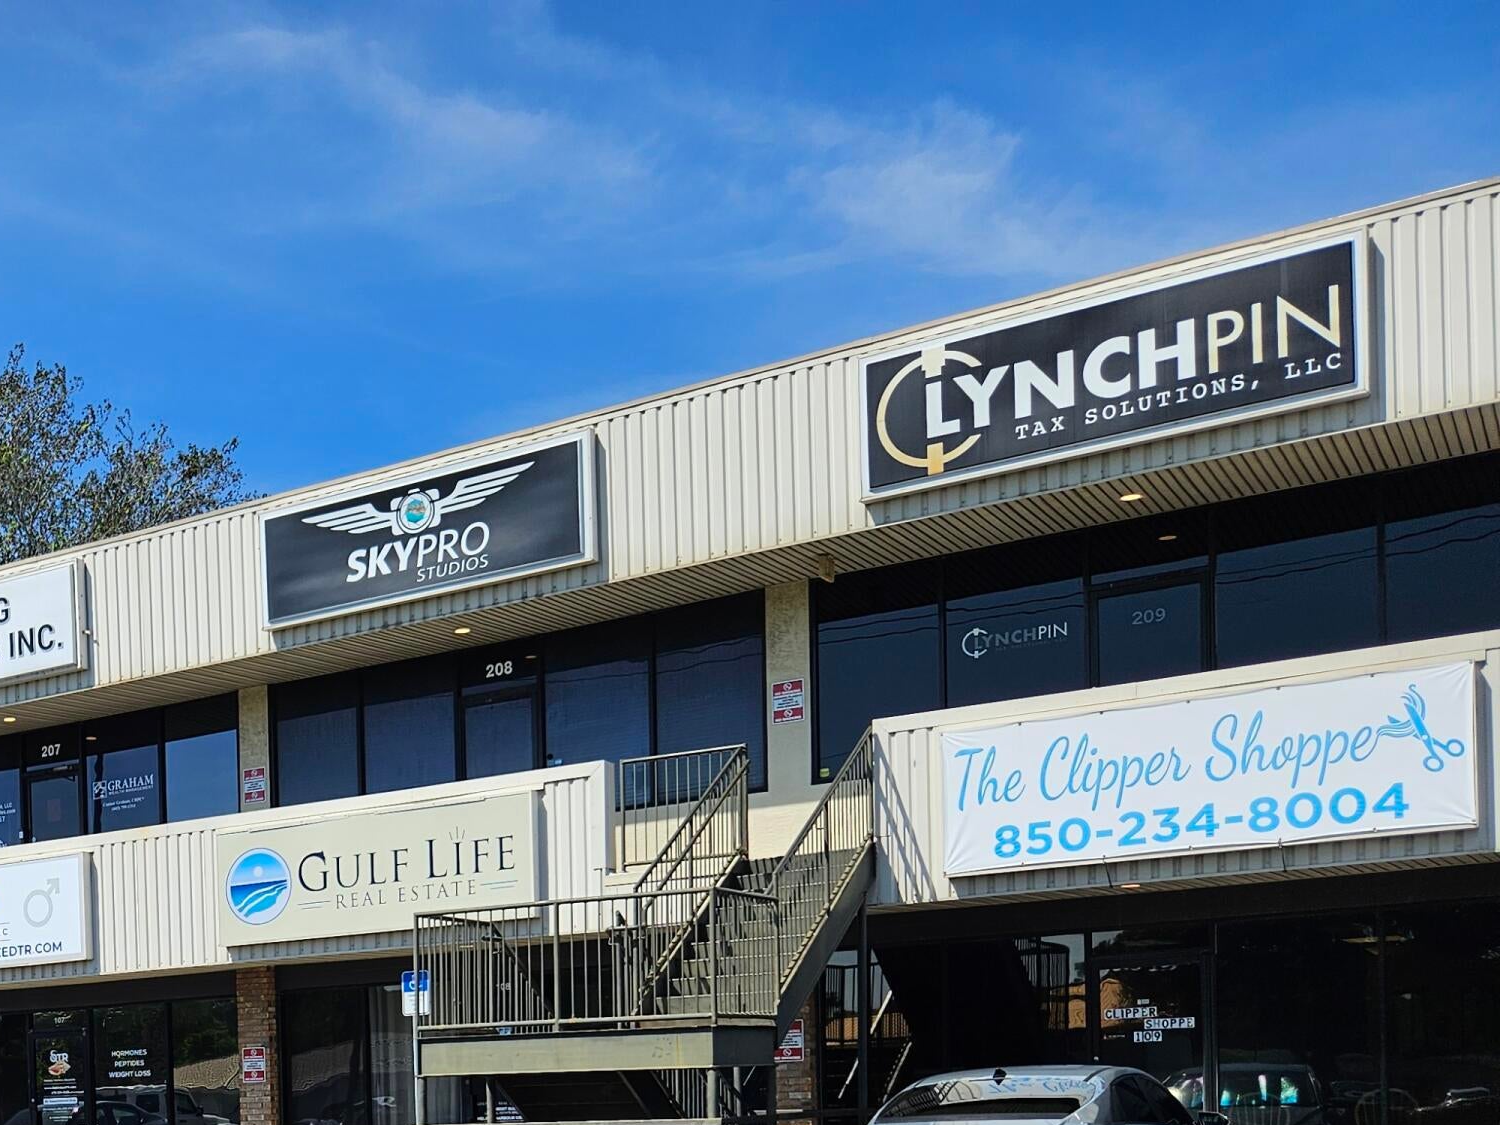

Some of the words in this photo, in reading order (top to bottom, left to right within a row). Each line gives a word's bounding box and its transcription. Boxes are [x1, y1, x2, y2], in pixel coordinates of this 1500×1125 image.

[925, 284, 1341, 439] LYNCHPIN
[1014, 416, 1066, 441] TAX
[1084, 373, 1262, 425] SOLUTIONS,
[1283, 352, 1343, 380] LLC
[345, 521, 491, 583] SKYPRO
[416, 554, 489, 582] STUDIOS
[1131, 607, 1166, 625] 209
[9, 624, 64, 658] INC.
[973, 621, 1068, 650] LYNCHPIN
[485, 660, 513, 679] 208
[40, 743, 61, 759] 207
[953, 745, 1026, 812] The
[1039, 731, 1192, 811] Clipper
[1204, 709, 1376, 789] Shoppe
[107, 774, 154, 791] GRAHAM
[993, 782, 1410, 859] 850-234-8004
[336, 890, 387, 910] REAL
[398, 879, 477, 902] ESTATE
[1104, 1007, 1157, 1019] CLIPPER
[1144, 1018, 1194, 1029] SHOPPE
[1134, 1031, 1161, 1042] 109
[111, 1049, 148, 1057] HORMONES
[114, 1059, 145, 1067] PEPTIDES
[108, 1070, 134, 1078] WEIGHT
[134, 1069, 152, 1077] LOSS
